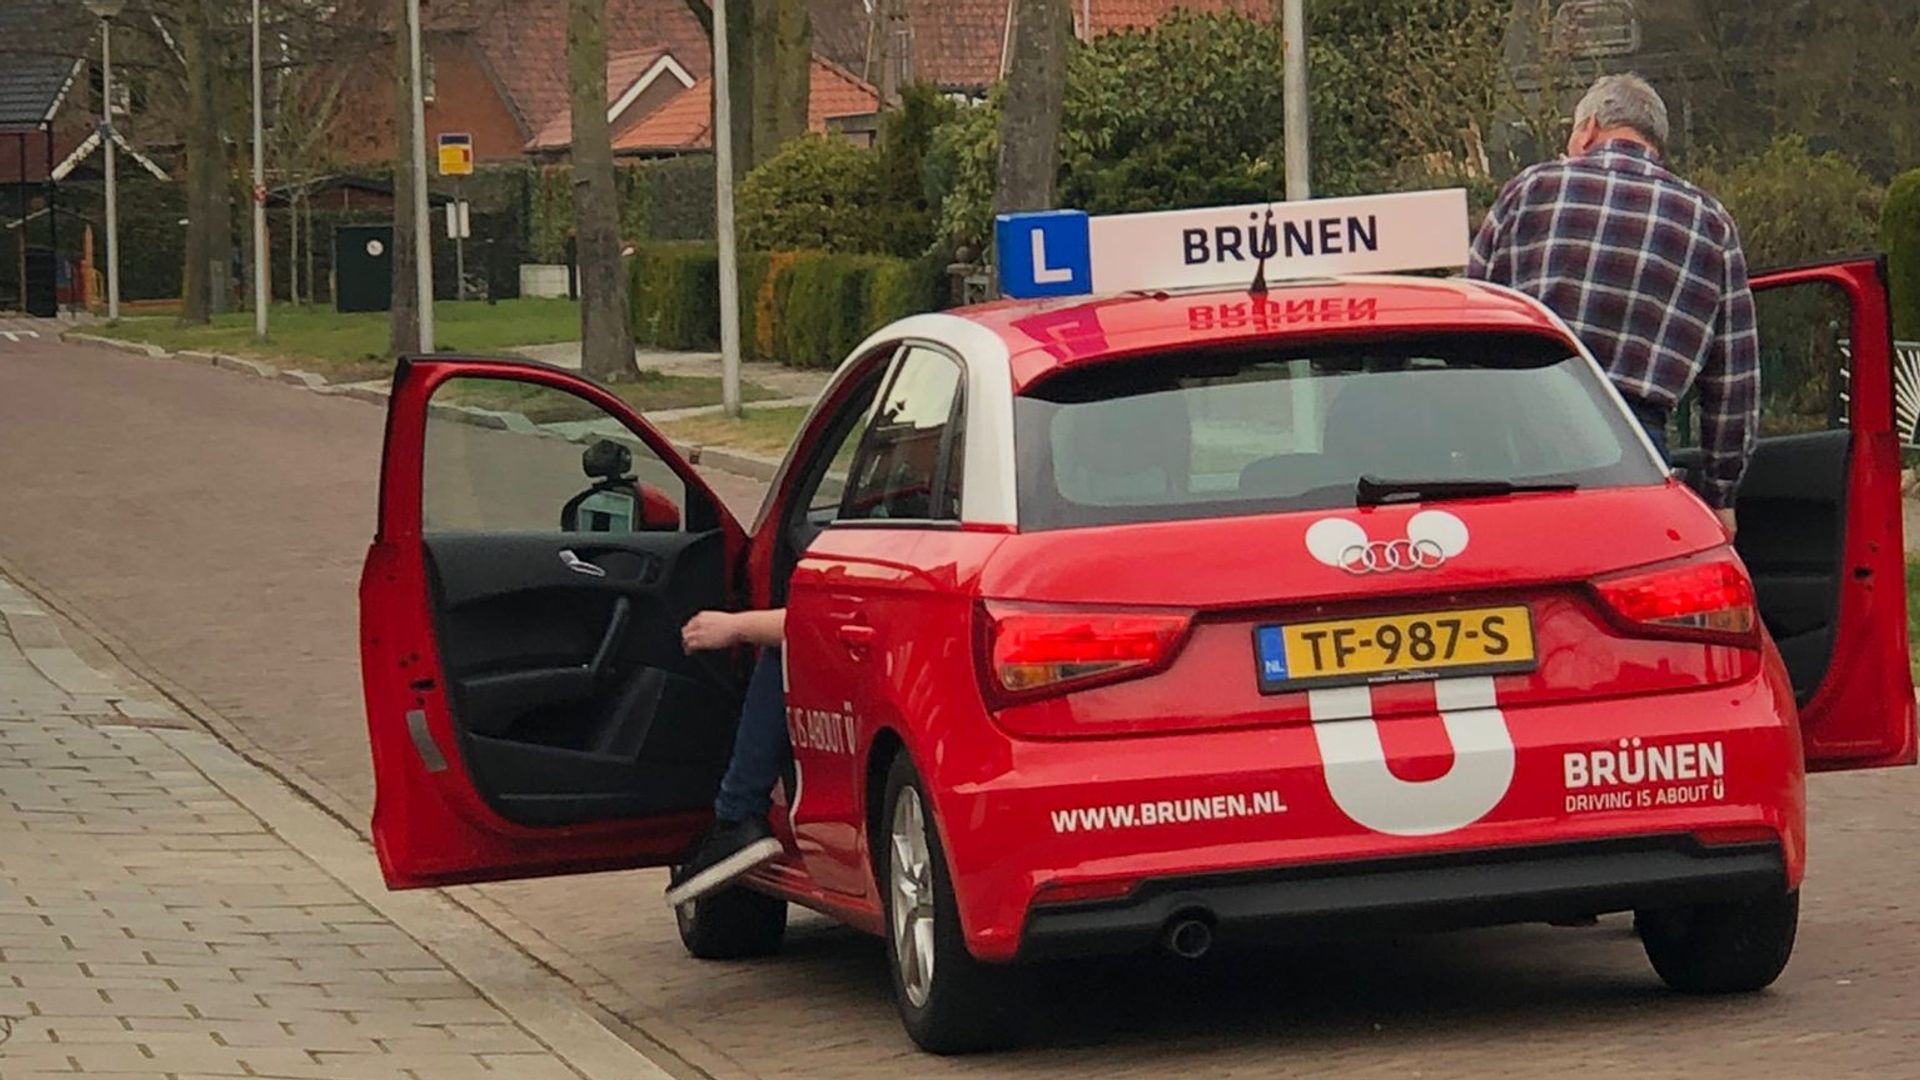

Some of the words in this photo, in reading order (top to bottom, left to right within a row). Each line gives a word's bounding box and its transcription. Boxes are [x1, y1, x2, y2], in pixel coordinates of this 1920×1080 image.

[1030, 228, 1073, 285] L
[1183, 210, 1377, 265] BRÜNEN
[1265, 659, 1285, 674] NL
[1301, 616, 1510, 671] TF-987-S
[1564, 736, 1725, 789] BRÜNEN
[1051, 790, 1288, 833] WWW.BRUNEN.NL
[1565, 790, 1633, 813] DRIVING
[1637, 789, 1651, 808] IS
[1656, 784, 1709, 806] ABOUT
[1713, 778, 1725, 800] Ü
